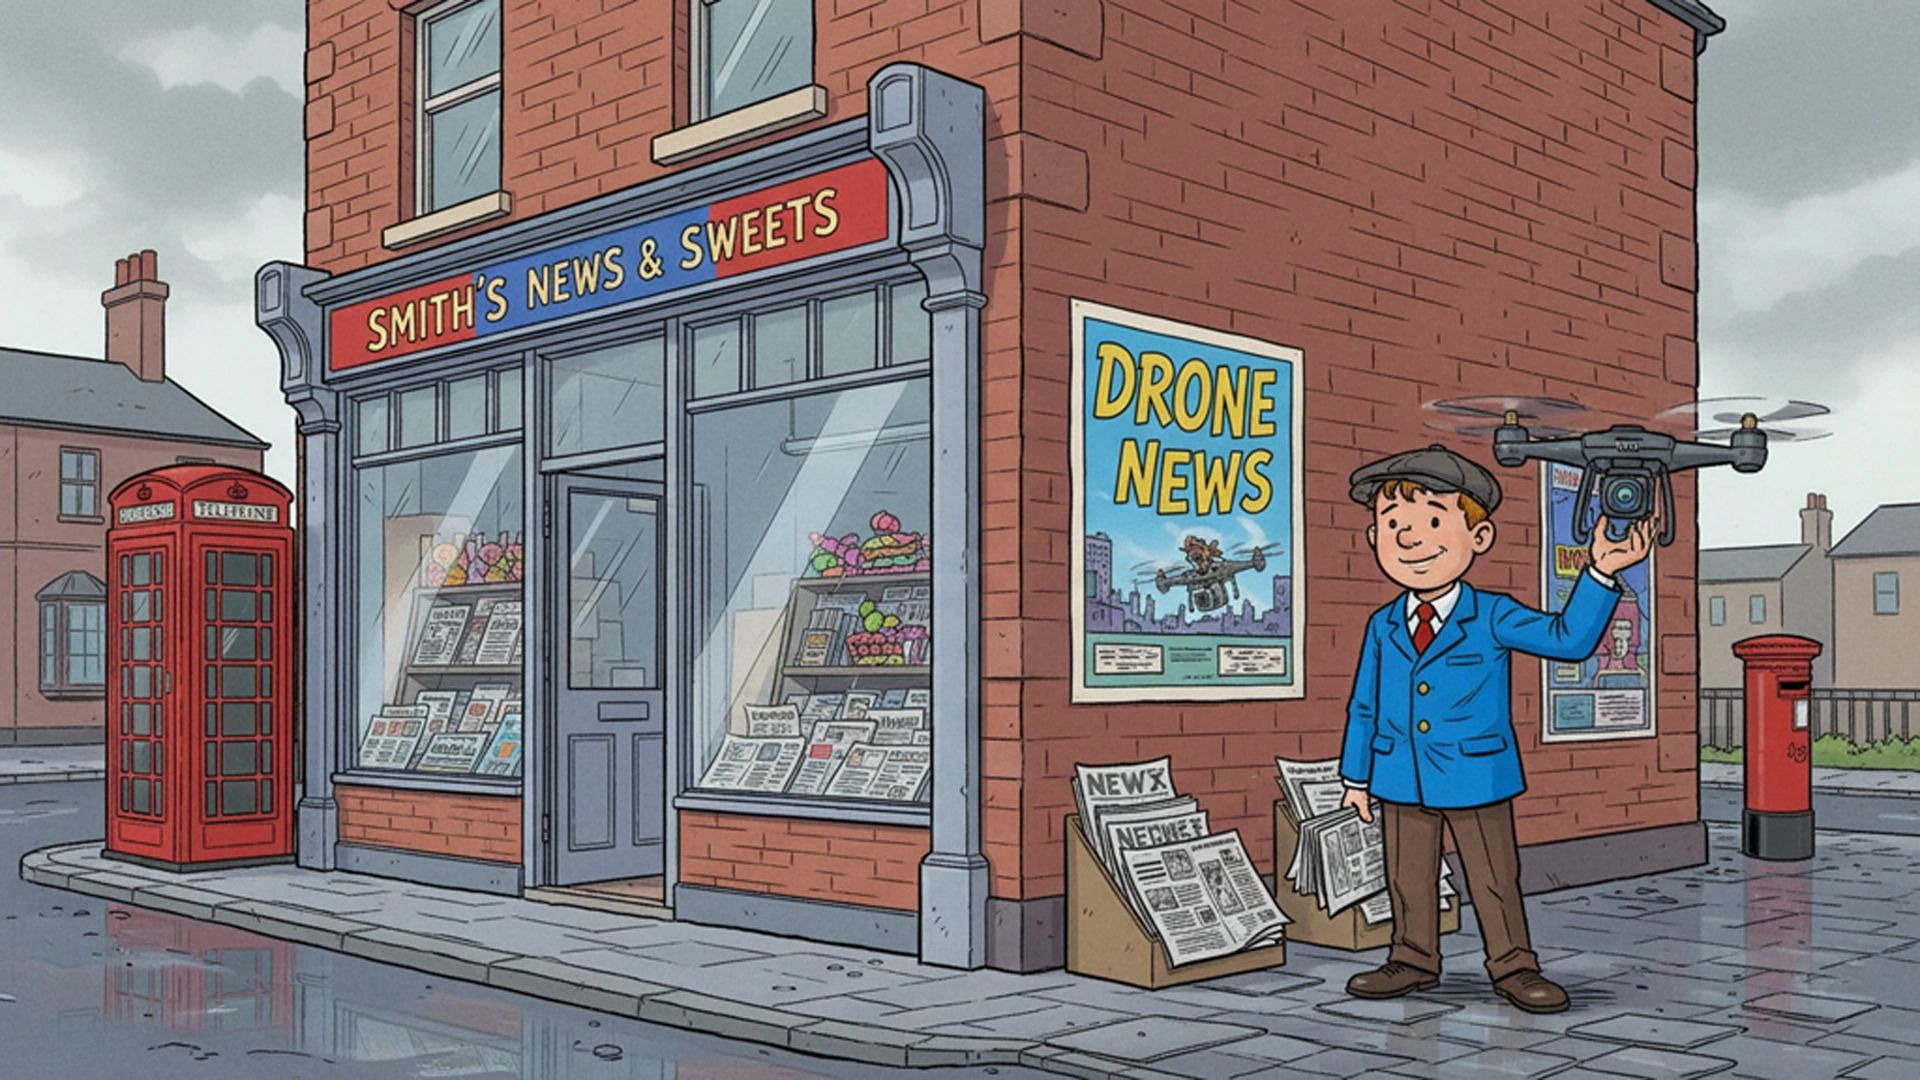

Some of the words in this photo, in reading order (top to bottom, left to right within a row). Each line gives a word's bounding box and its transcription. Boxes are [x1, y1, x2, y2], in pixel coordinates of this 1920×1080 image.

[366, 275, 508, 352] SMITH'S
[527, 246, 625, 310] NEWS
[637, 236, 665, 281] &
[679, 187, 839, 270] SWEETS
[1093, 341, 1278, 439] DRONE
[1114, 438, 1274, 517] NEWS
